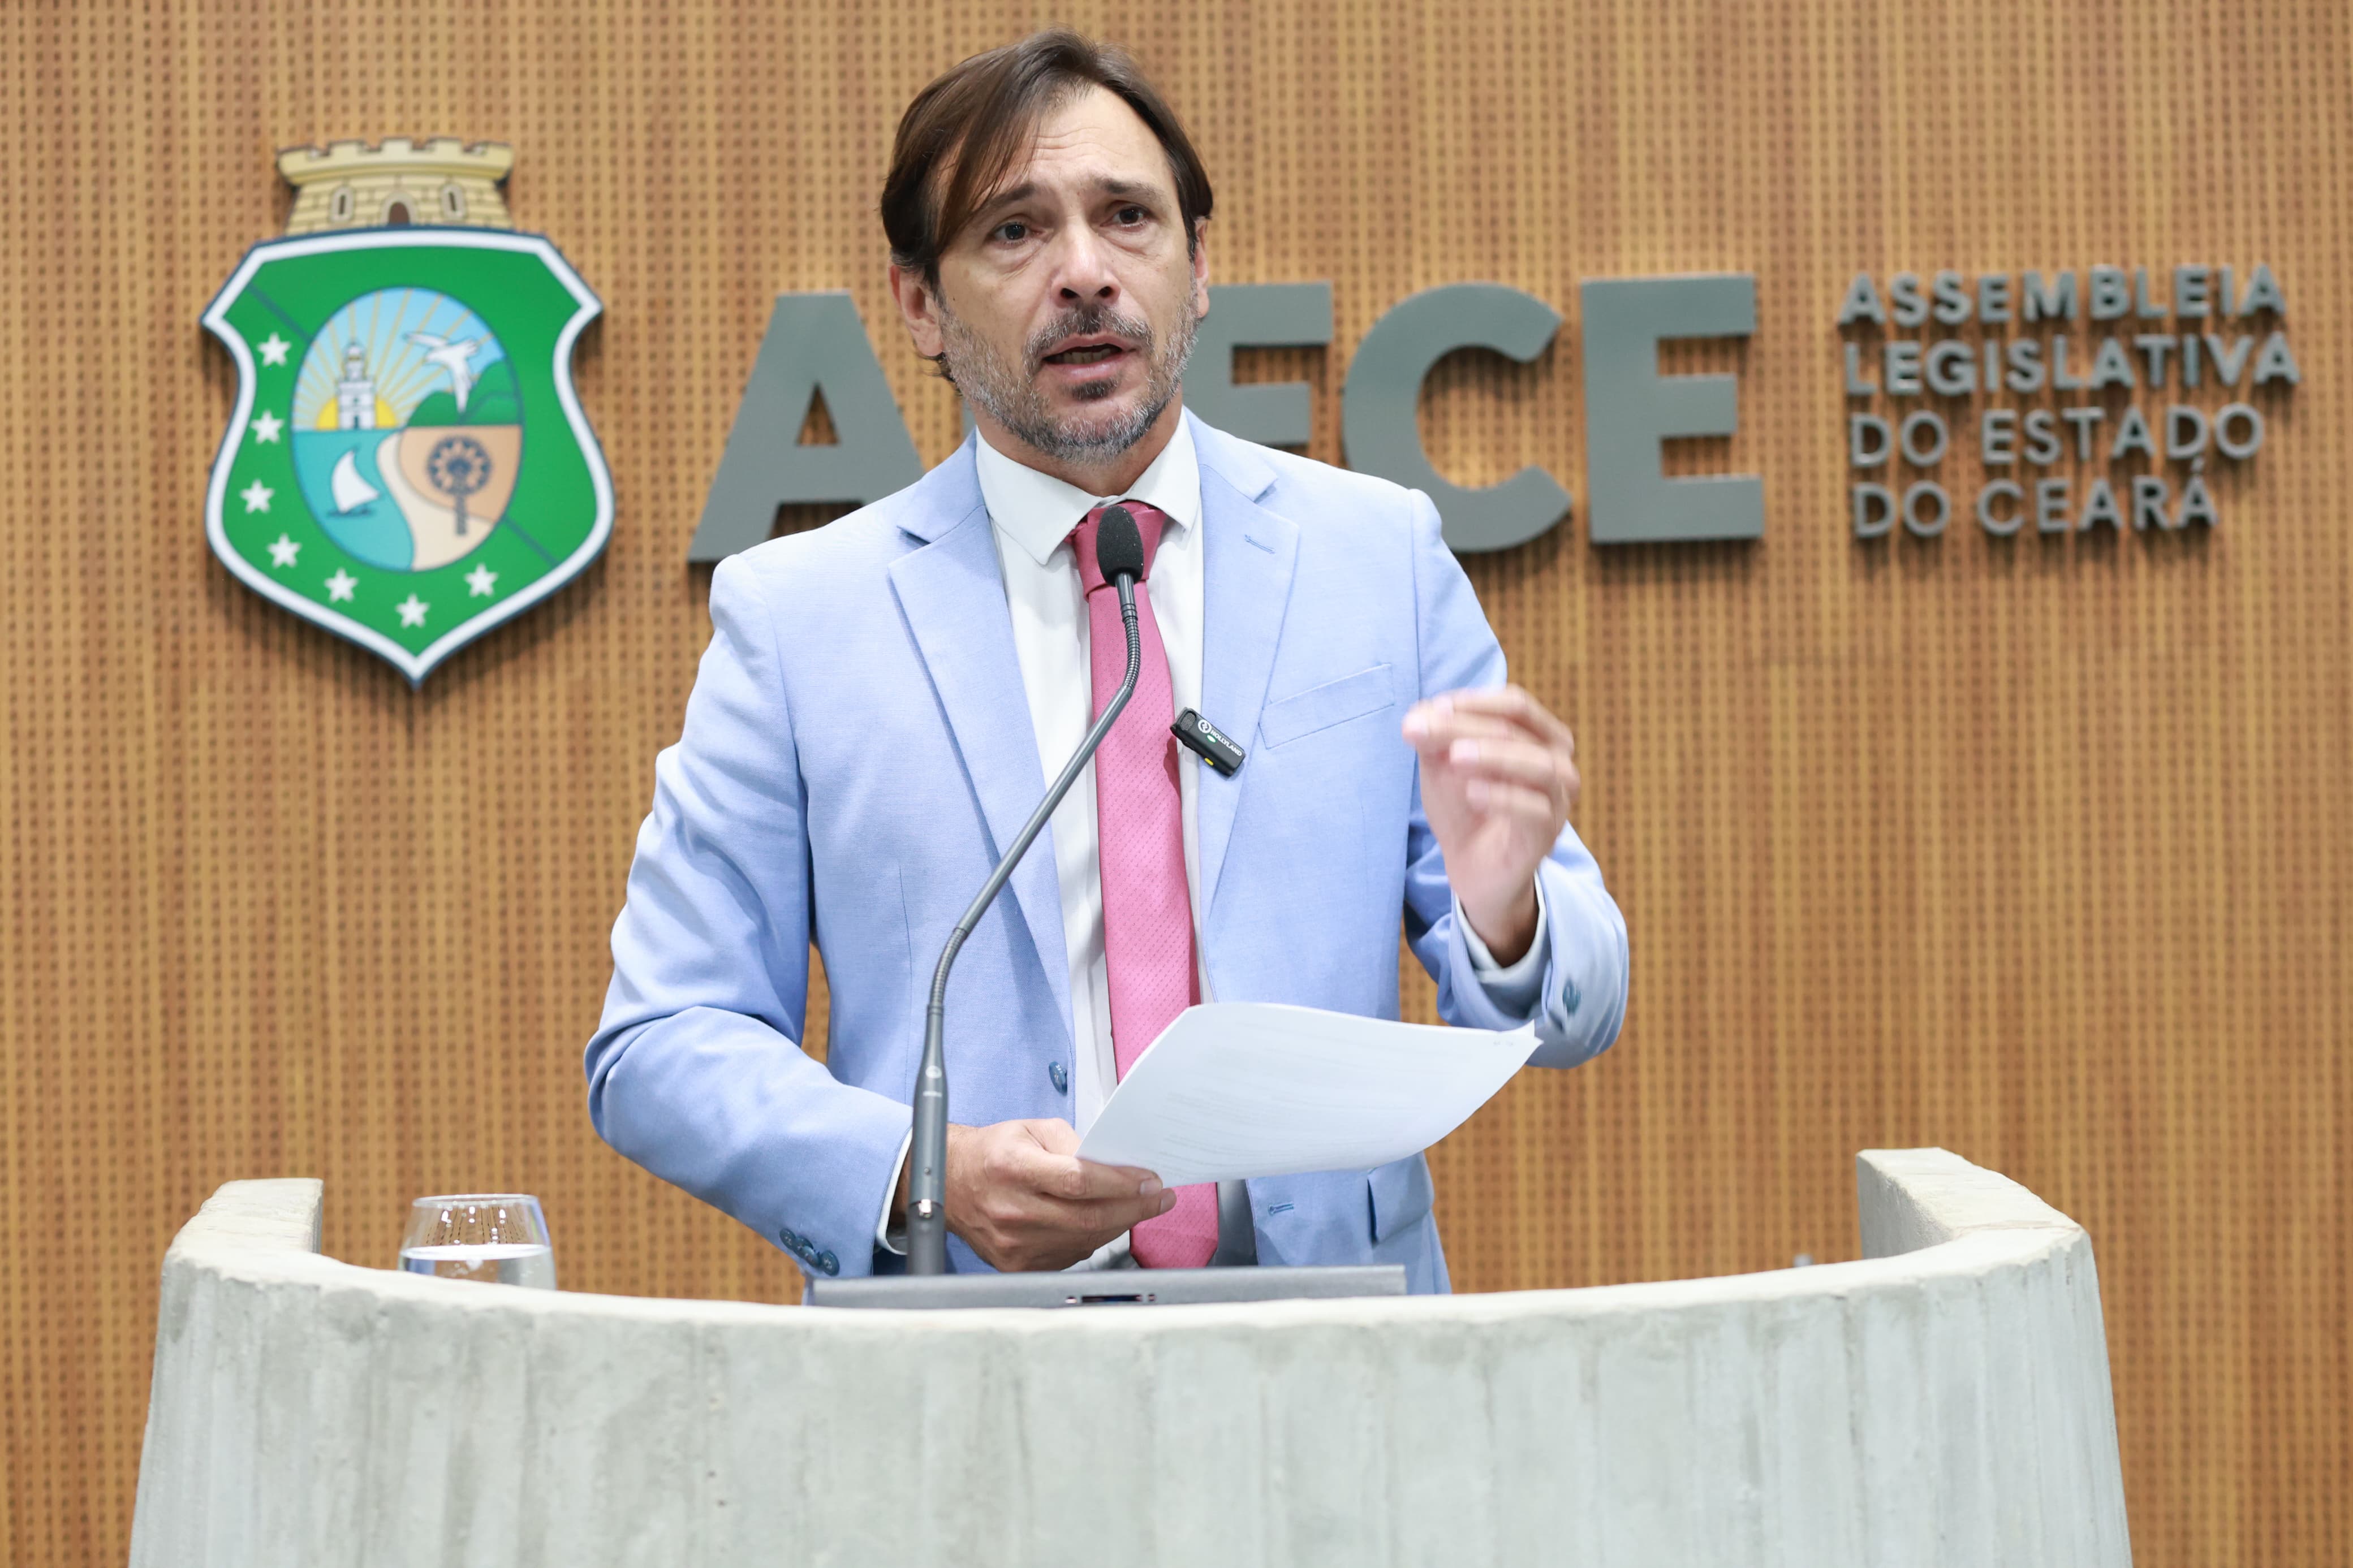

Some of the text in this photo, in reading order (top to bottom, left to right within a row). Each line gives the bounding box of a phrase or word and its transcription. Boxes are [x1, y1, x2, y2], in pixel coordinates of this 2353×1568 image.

[1838, 262, 2287, 327] ASSEMBLEIA
[1844, 331, 2301, 395] LEGISLATIVA
[687, 275, 1764, 559] AECE
[1850, 402, 2265, 467] DO ESTADO
[1854, 457, 2219, 537] DO CEARÁ
[1210, 729, 1243, 757] HOLLYLAND
